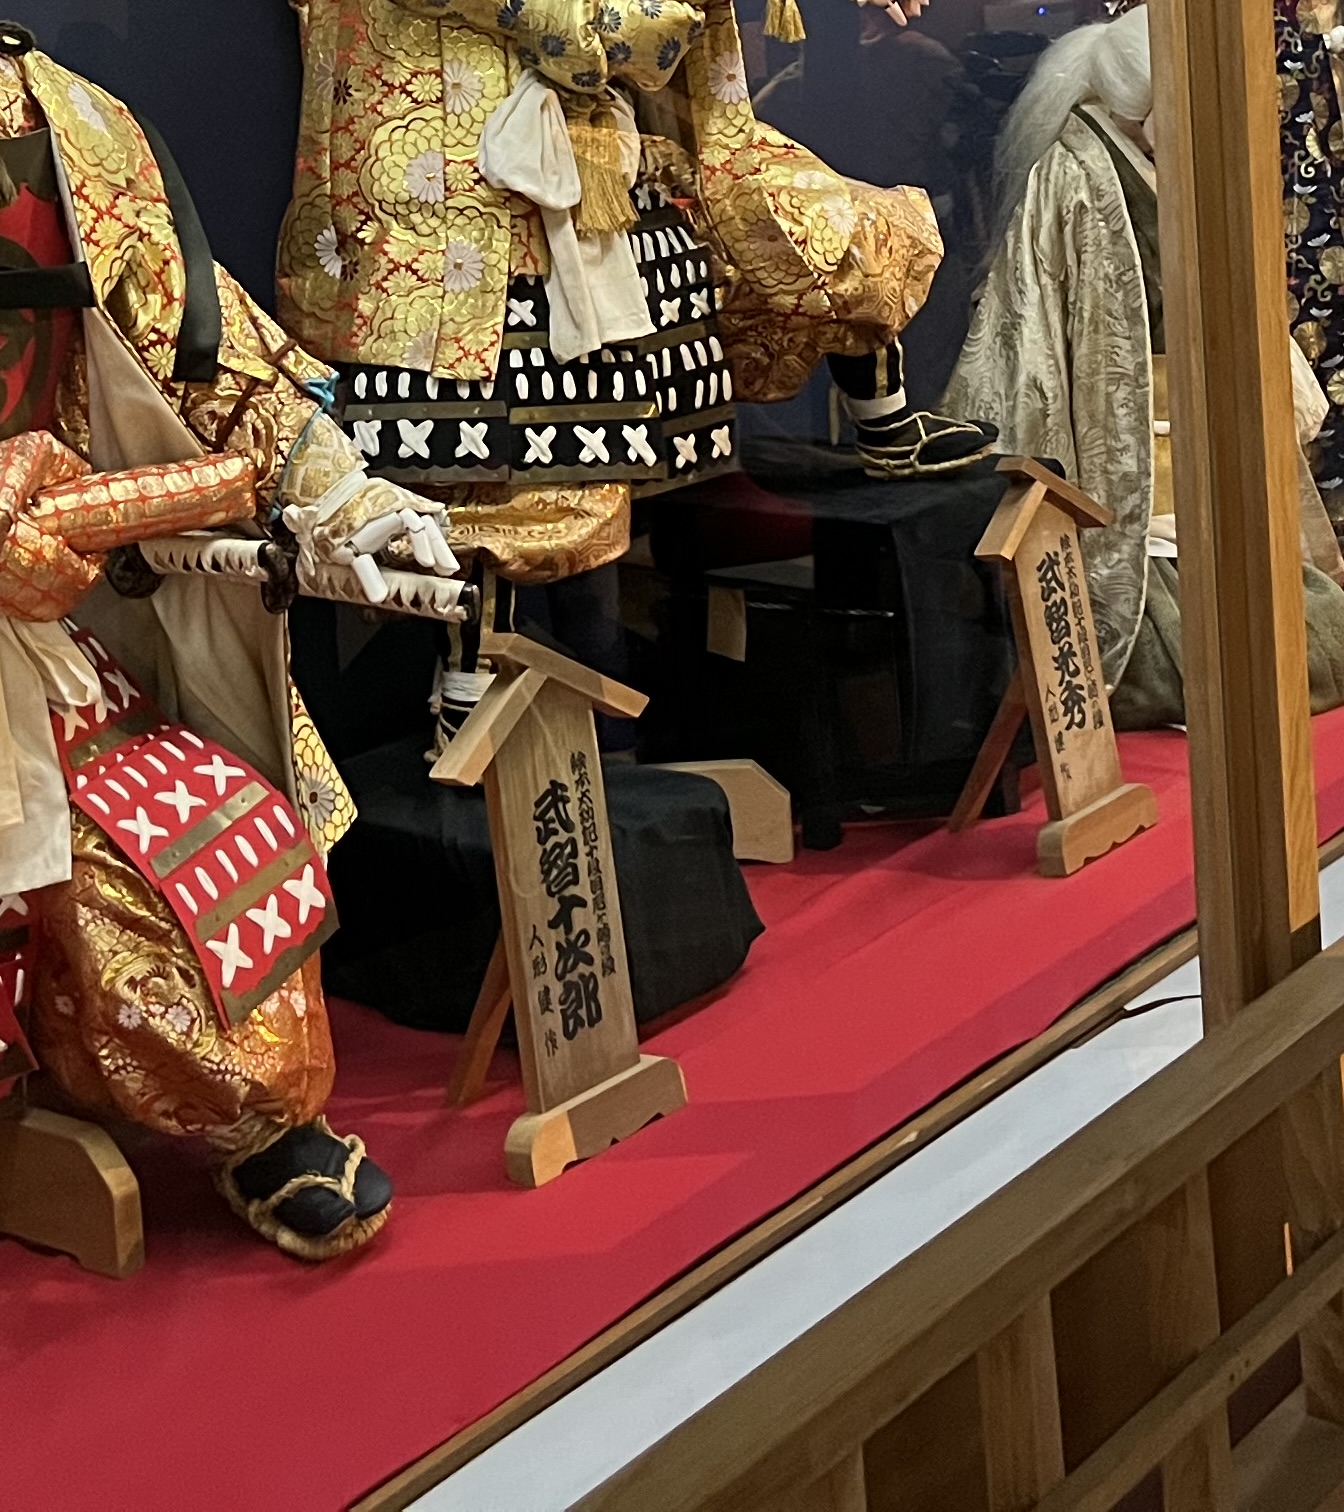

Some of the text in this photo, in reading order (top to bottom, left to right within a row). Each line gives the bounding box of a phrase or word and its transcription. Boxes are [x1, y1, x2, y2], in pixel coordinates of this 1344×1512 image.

[1036, 550, 1087, 731] 武智光秀
[532, 779, 603, 1042] 武智十次郎
